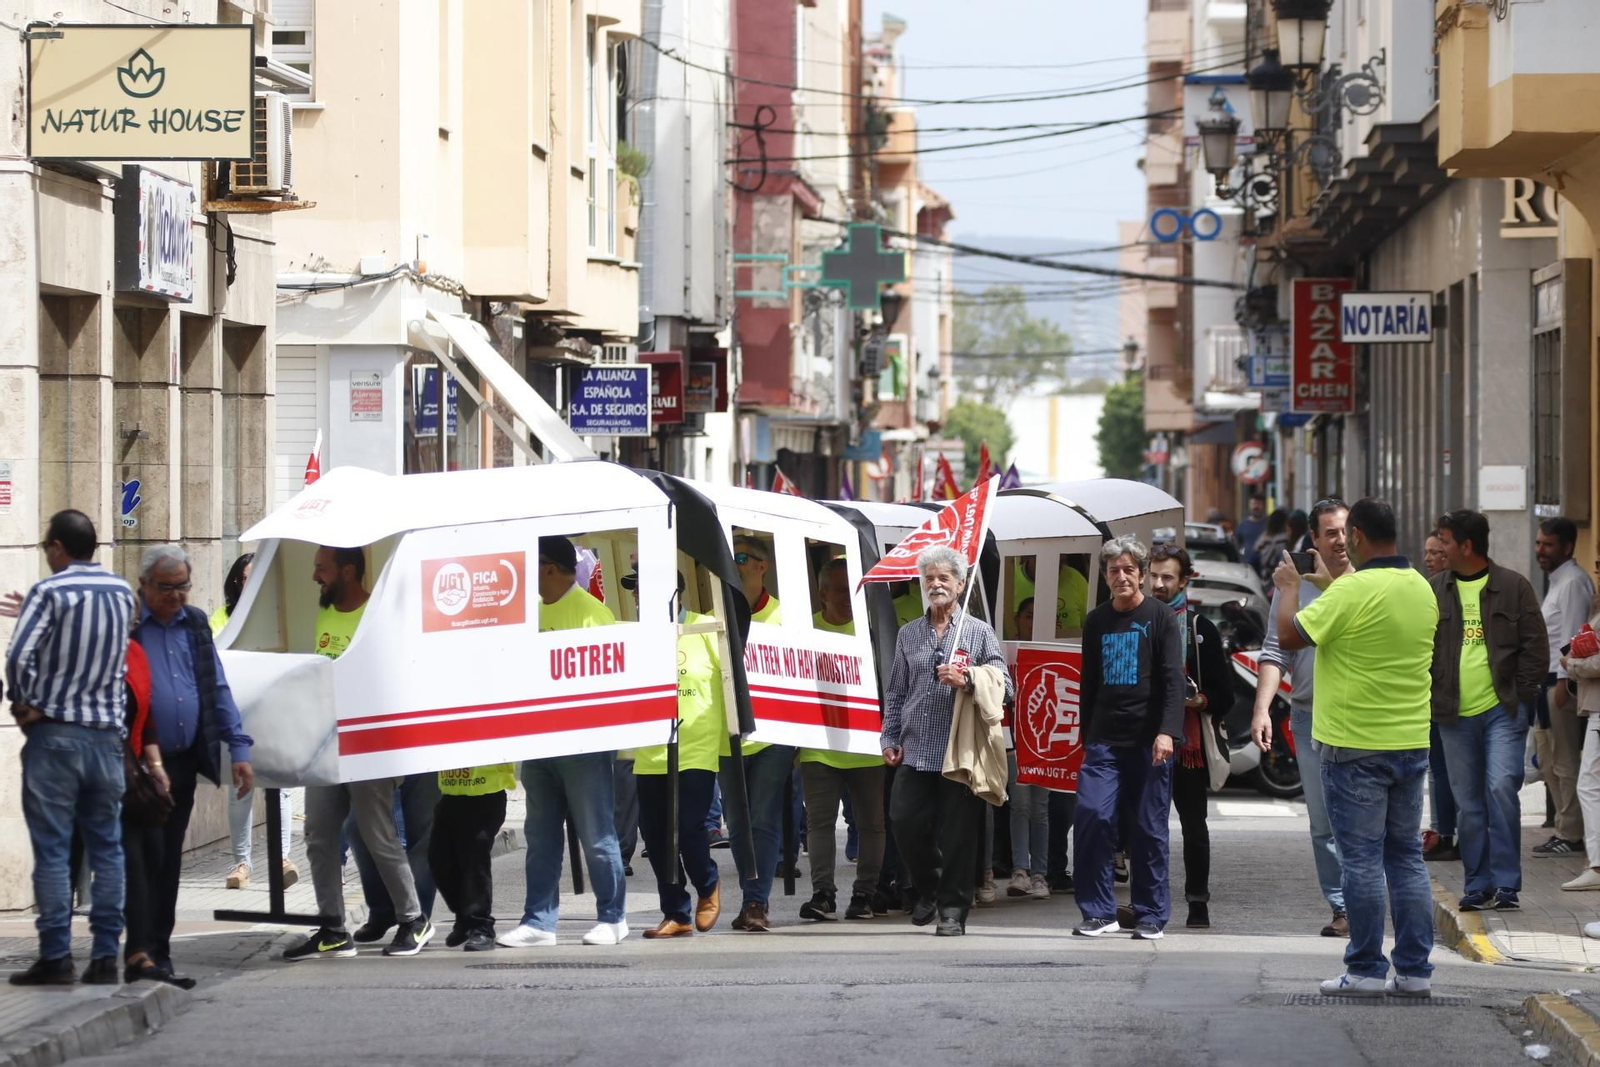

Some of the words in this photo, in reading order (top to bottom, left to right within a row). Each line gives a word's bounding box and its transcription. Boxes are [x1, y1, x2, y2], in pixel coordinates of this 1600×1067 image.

[41, 107, 141, 134] NATUR
[148, 107, 246, 134] HOUSE
[1343, 297, 1429, 335] NOTARÍA
[1310, 284, 1336, 379] BAZAR
[595, 369, 637, 381] ALIANZA
[584, 384, 631, 399] ESPAÑOLA
[1297, 383, 1349, 398] CHEN
[571, 403, 589, 415] S.A.
[590, 403, 603, 415] DE
[605, 403, 647, 416] SEGUROS
[438, 572, 465, 592] UGT
[473, 570, 498, 585] FICA
[550, 641, 625, 681] UGTREN
[744, 643, 759, 673] SIN
[758, 644, 784, 679] TREN,
[783, 647, 797, 678] NO
[797, 648, 815, 680] HAY
[1050, 677, 1080, 746] UGT
[459, 776, 486, 787] FUTURO
